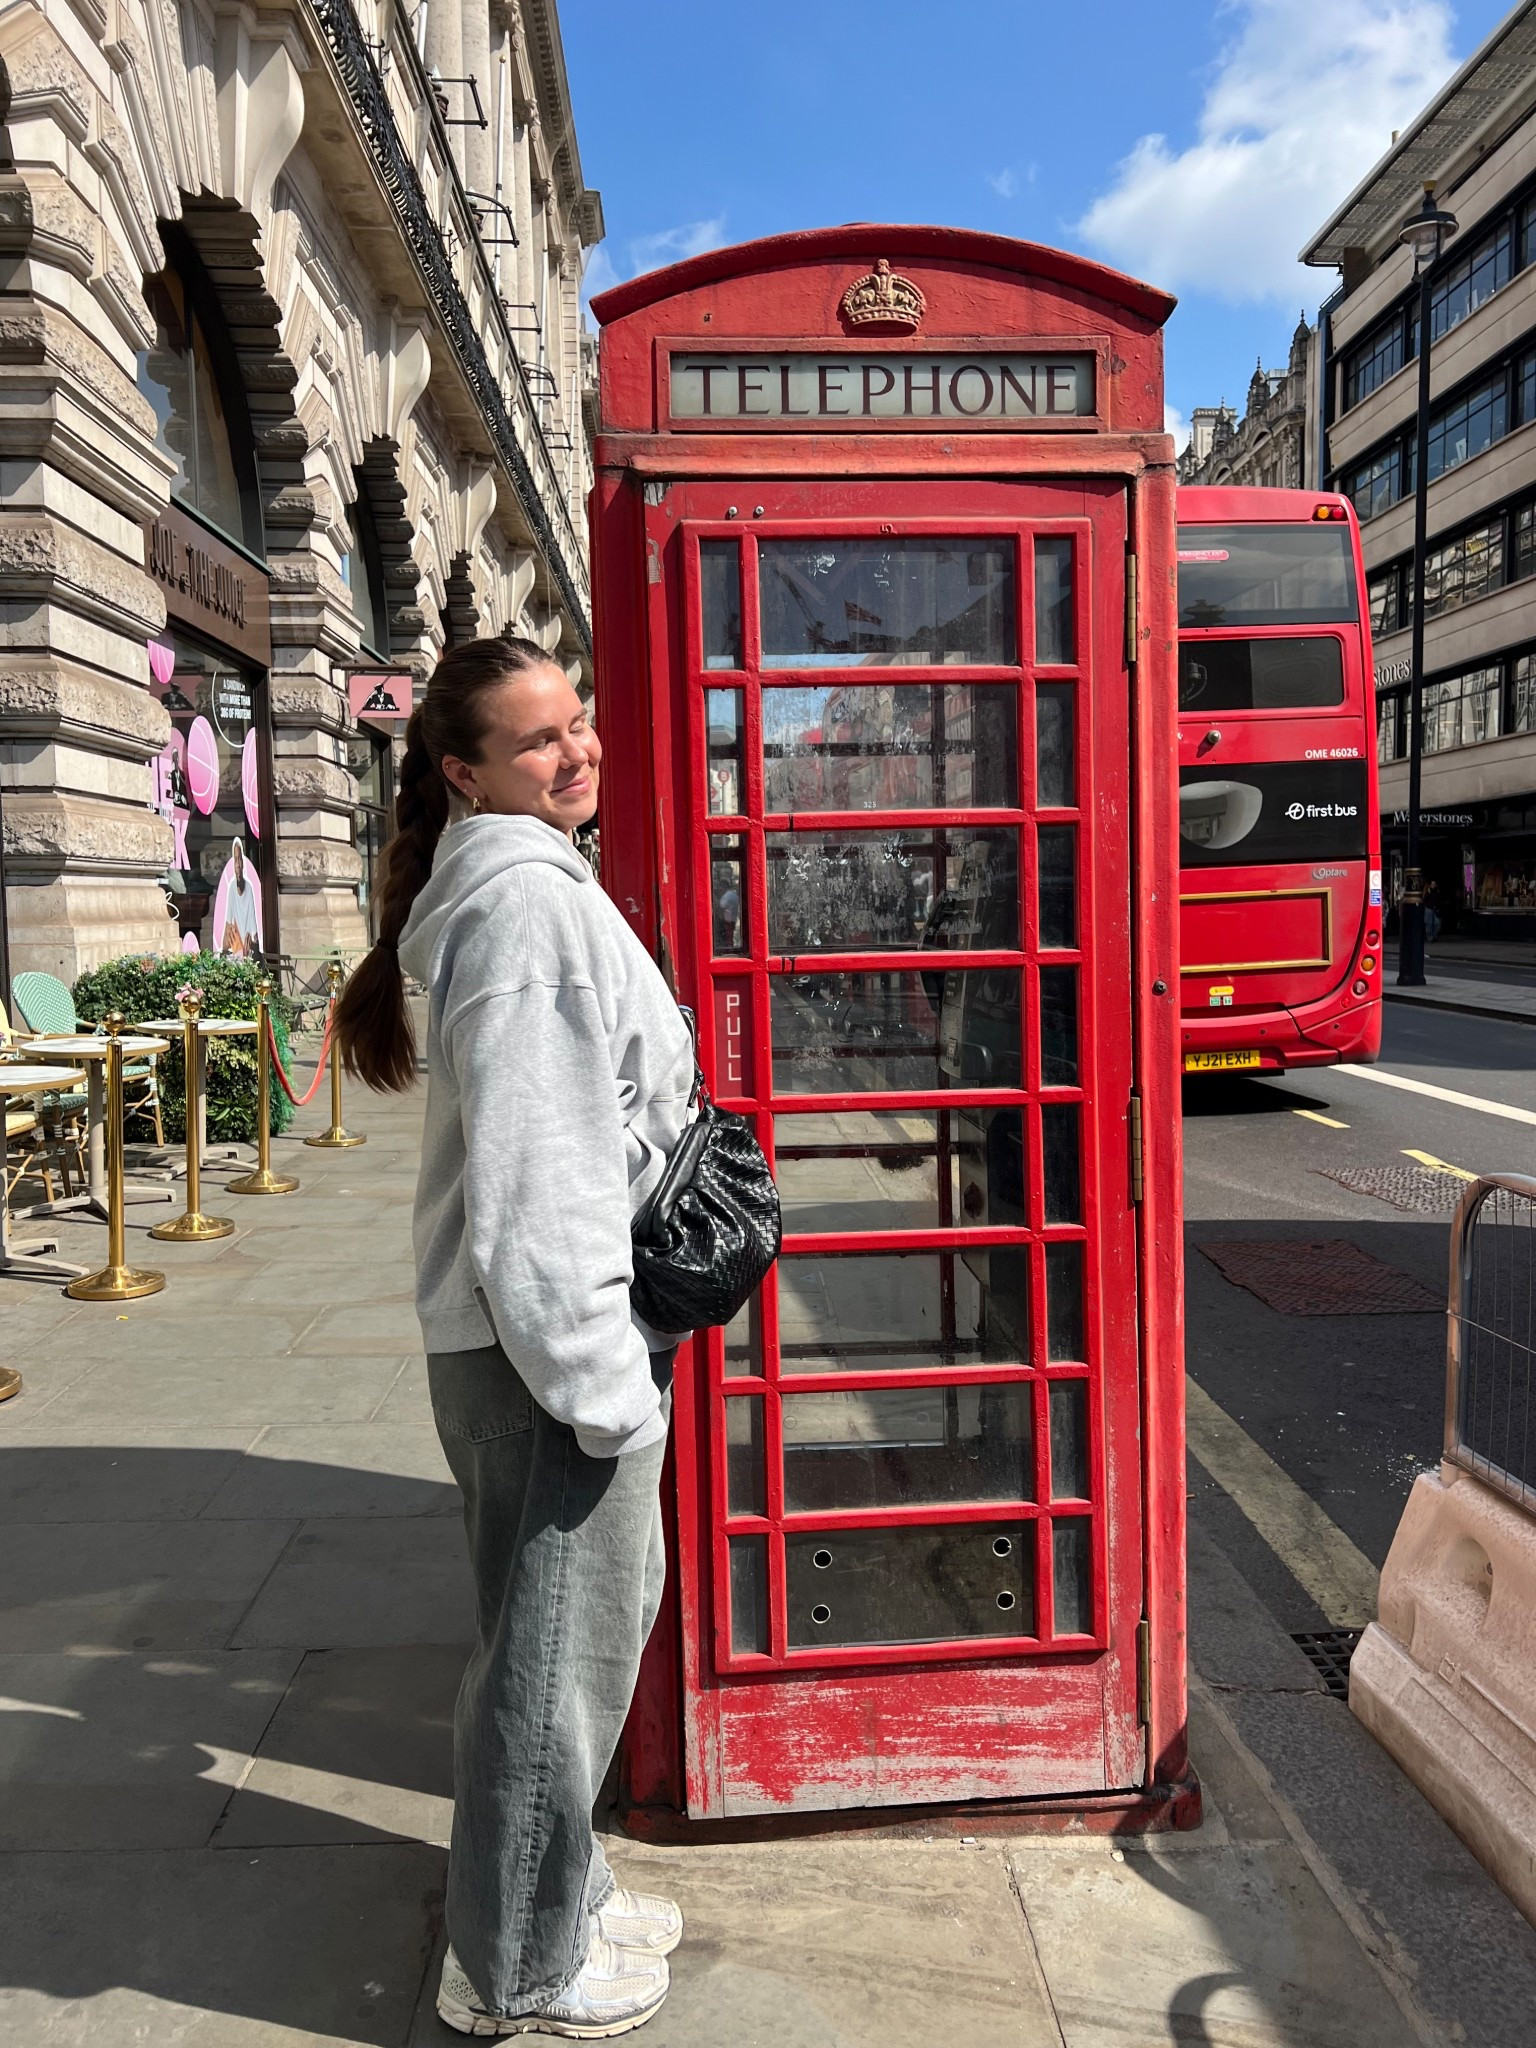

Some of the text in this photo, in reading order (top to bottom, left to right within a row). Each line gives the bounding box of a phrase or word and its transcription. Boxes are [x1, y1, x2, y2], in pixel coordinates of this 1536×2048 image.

[684, 364, 1077, 416] TELEPHONE
[1374, 659, 1411, 687] stones
[1305, 748, 1358, 759] OME 46026
[1306, 804, 1357, 817] first bus
[1393, 810, 1473, 824] Werstones
[1319, 867, 1348, 878] Optare
[726, 993, 742, 1081] PULL
[1193, 1051, 1251, 1068] YJ21 EXH
